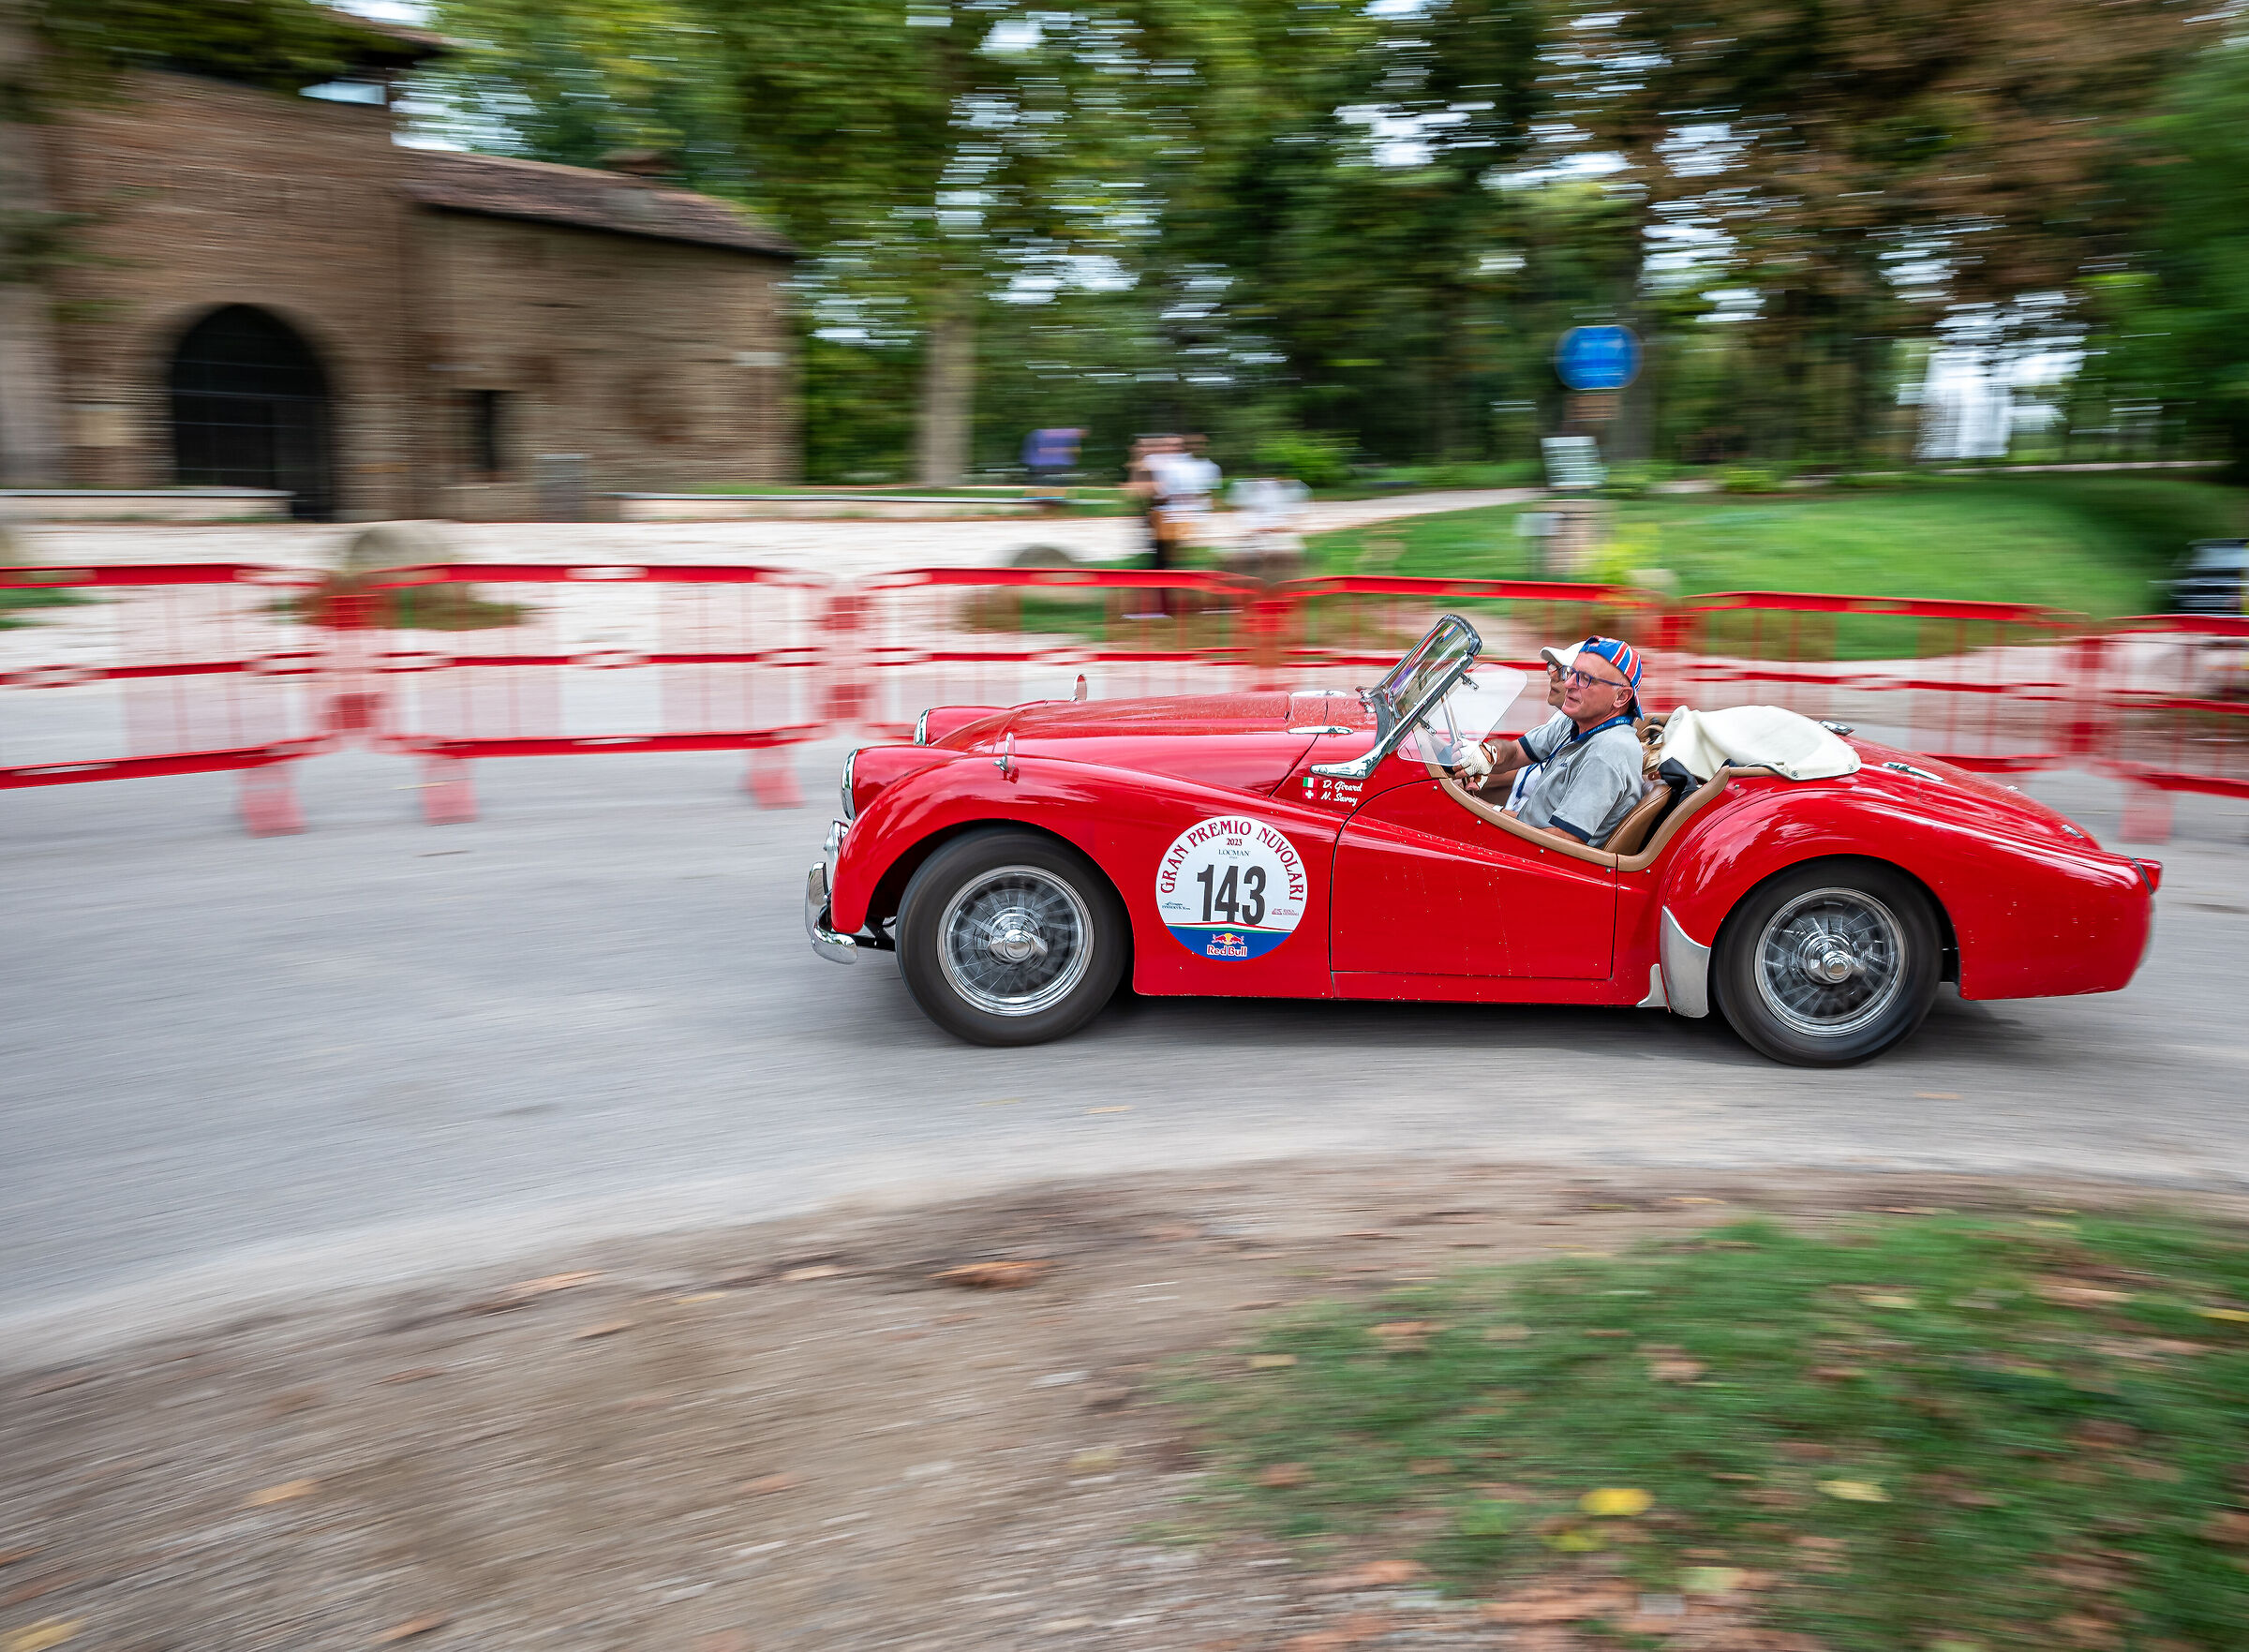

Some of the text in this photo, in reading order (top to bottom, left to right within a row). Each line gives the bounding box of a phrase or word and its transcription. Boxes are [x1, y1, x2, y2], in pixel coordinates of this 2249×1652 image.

[1322, 780, 1333, 789] D.
[1320, 791, 1358, 807] N. Savoy
[1160, 819, 1303, 901] GRAN PREMIO NUVOLARI
[1197, 864, 1267, 925] 143
[1207, 945, 1247, 957] Red Bull
